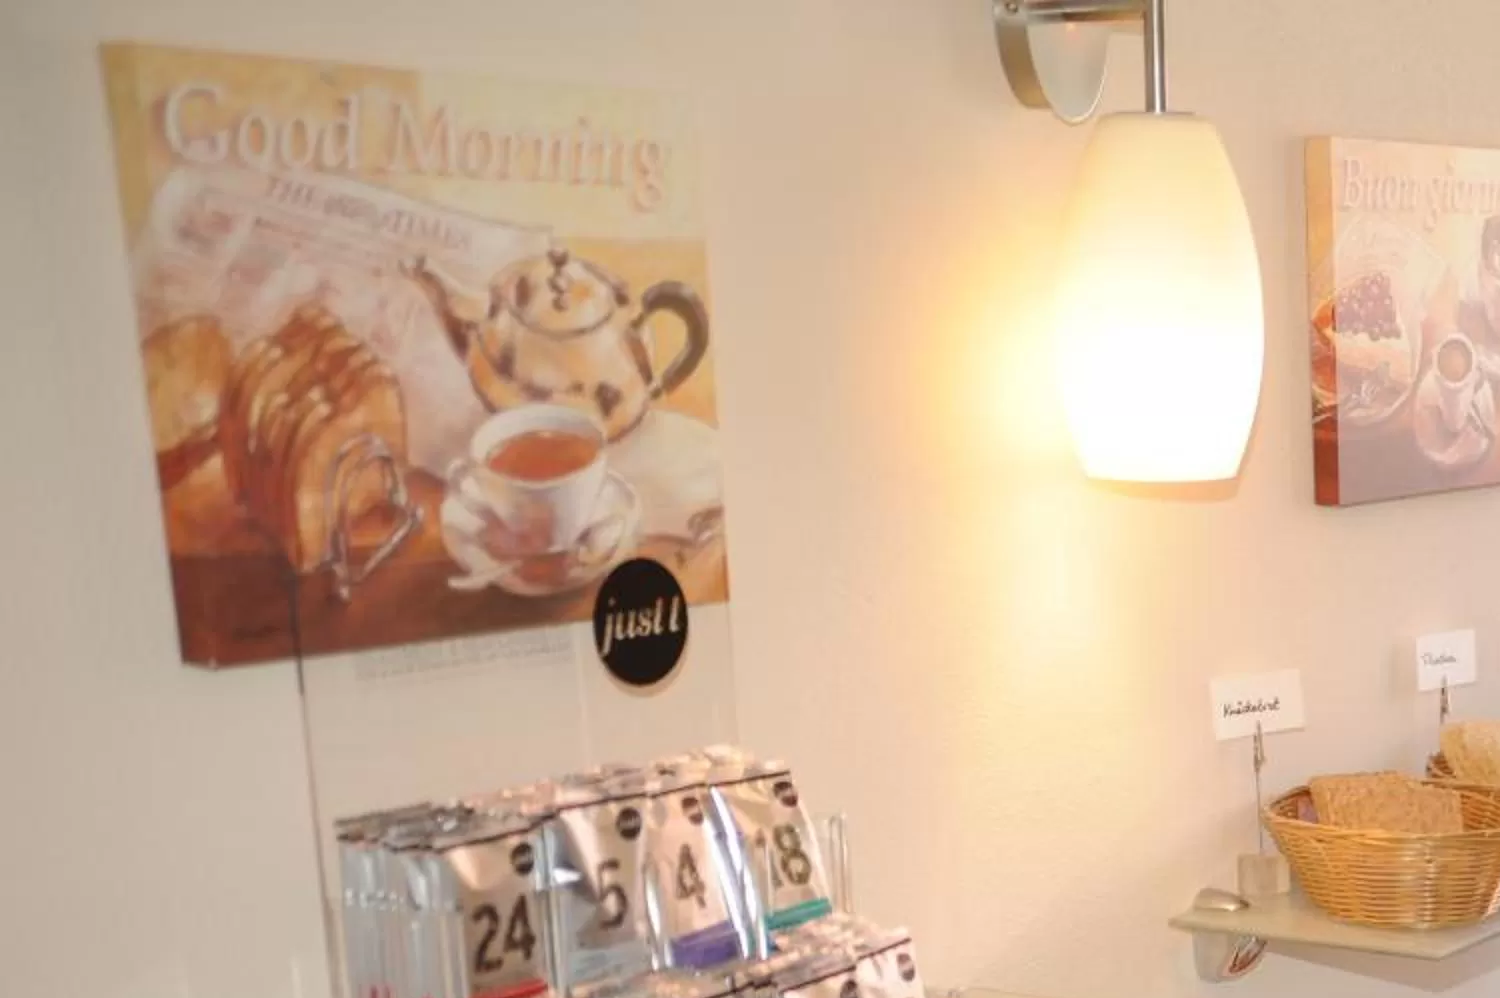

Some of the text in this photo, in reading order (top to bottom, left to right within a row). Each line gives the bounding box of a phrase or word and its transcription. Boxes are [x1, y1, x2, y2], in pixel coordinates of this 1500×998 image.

[157, 82, 666, 214] Good Morning
[601, 597, 663, 658] just
[676, 843, 706, 908] 4
[470, 893, 536, 973] 24
